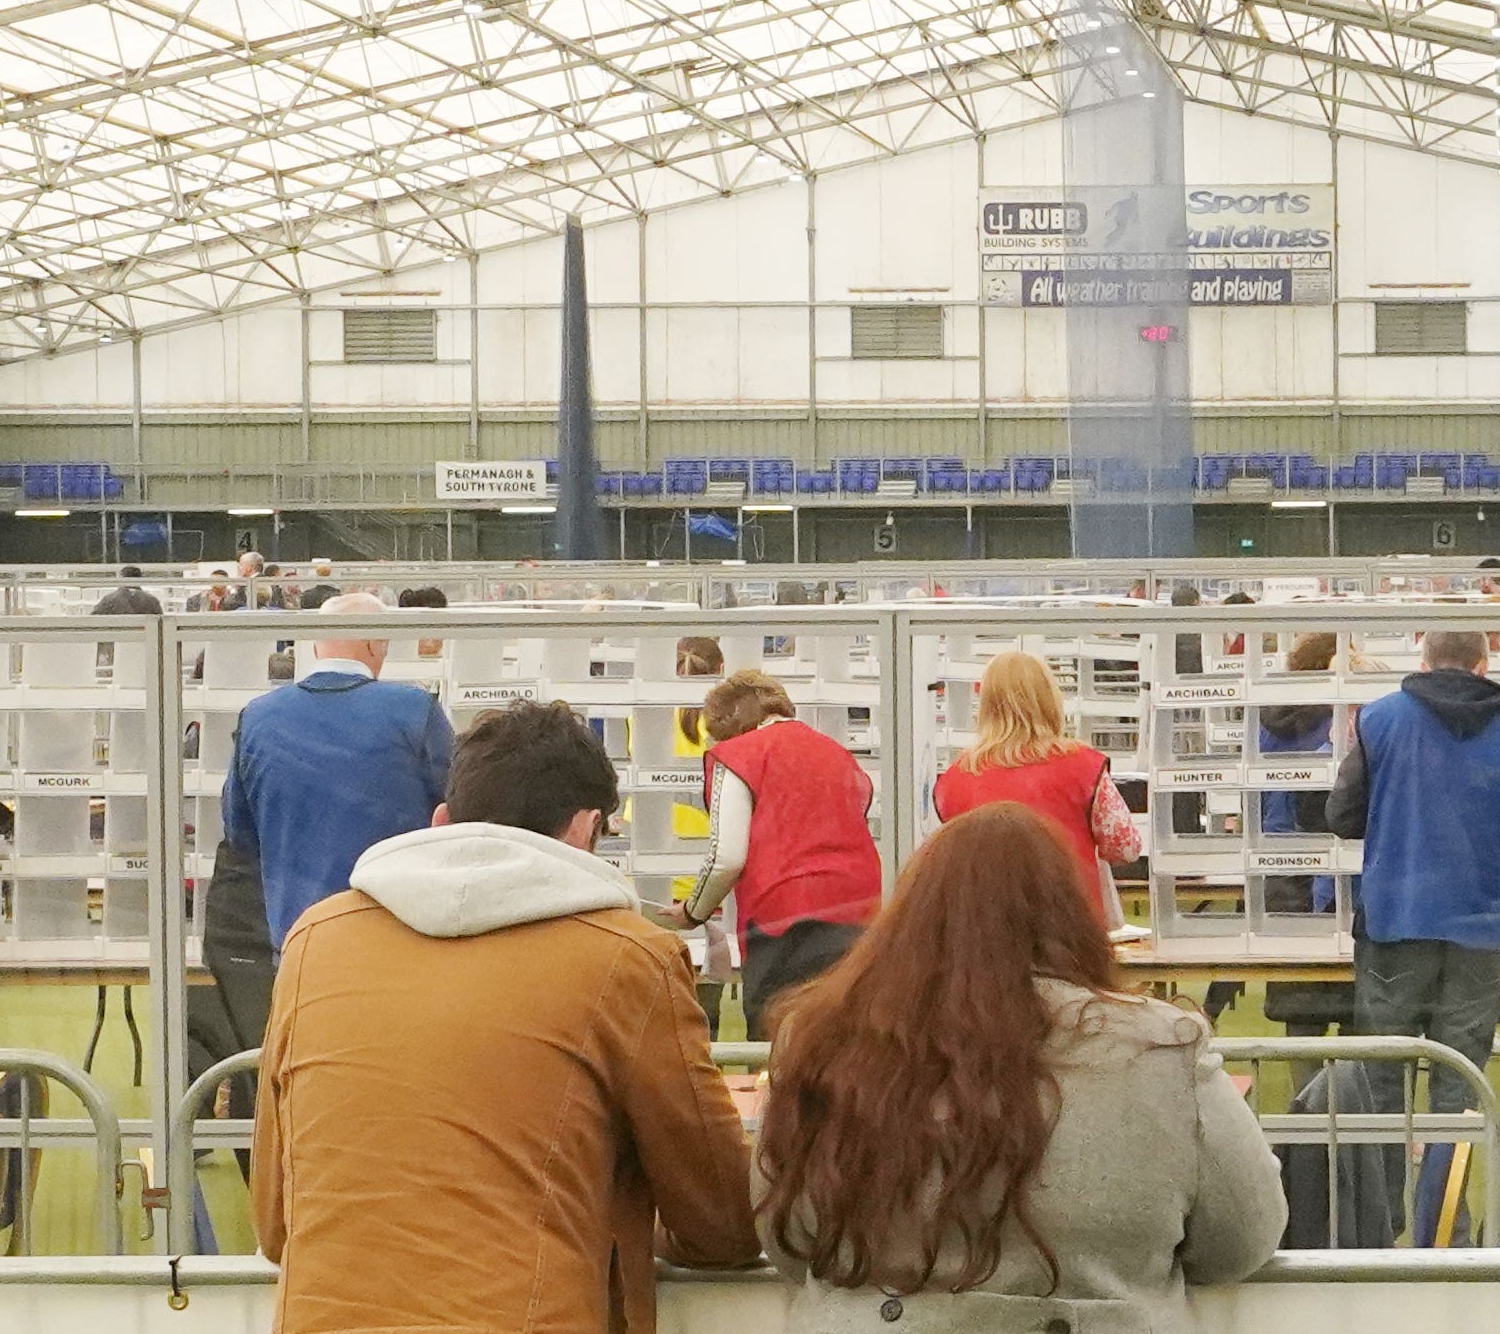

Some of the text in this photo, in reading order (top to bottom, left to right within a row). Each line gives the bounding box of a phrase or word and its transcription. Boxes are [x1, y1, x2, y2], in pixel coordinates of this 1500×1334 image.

[1187, 190, 1311, 215] Sports
[1018, 207, 1080, 230] RUBB
[984, 237, 1037, 249] BUILDING
[1184, 225, 1332, 249] uildings
[1029, 275, 1054, 304] All
[1190, 276, 1222, 303] and
[1223, 275, 1284, 303] playing
[446, 468, 535, 480] FERMANAGH &
[445, 481, 537, 493] SOUTH TYRONE
[878, 527, 893, 549] 5
[1437, 523, 1452, 545] 6
[463, 688, 534, 700] ARCHIBALD
[1165, 687, 1236, 700] ARCHIBALD
[37, 777, 91, 787] MCGURK
[651, 774, 705, 783] MCGURK
[1173, 771, 1223, 783] HUNTER
[1265, 770, 1312, 782] MCCAW
[1257, 856, 1321, 866] ROBINSON
